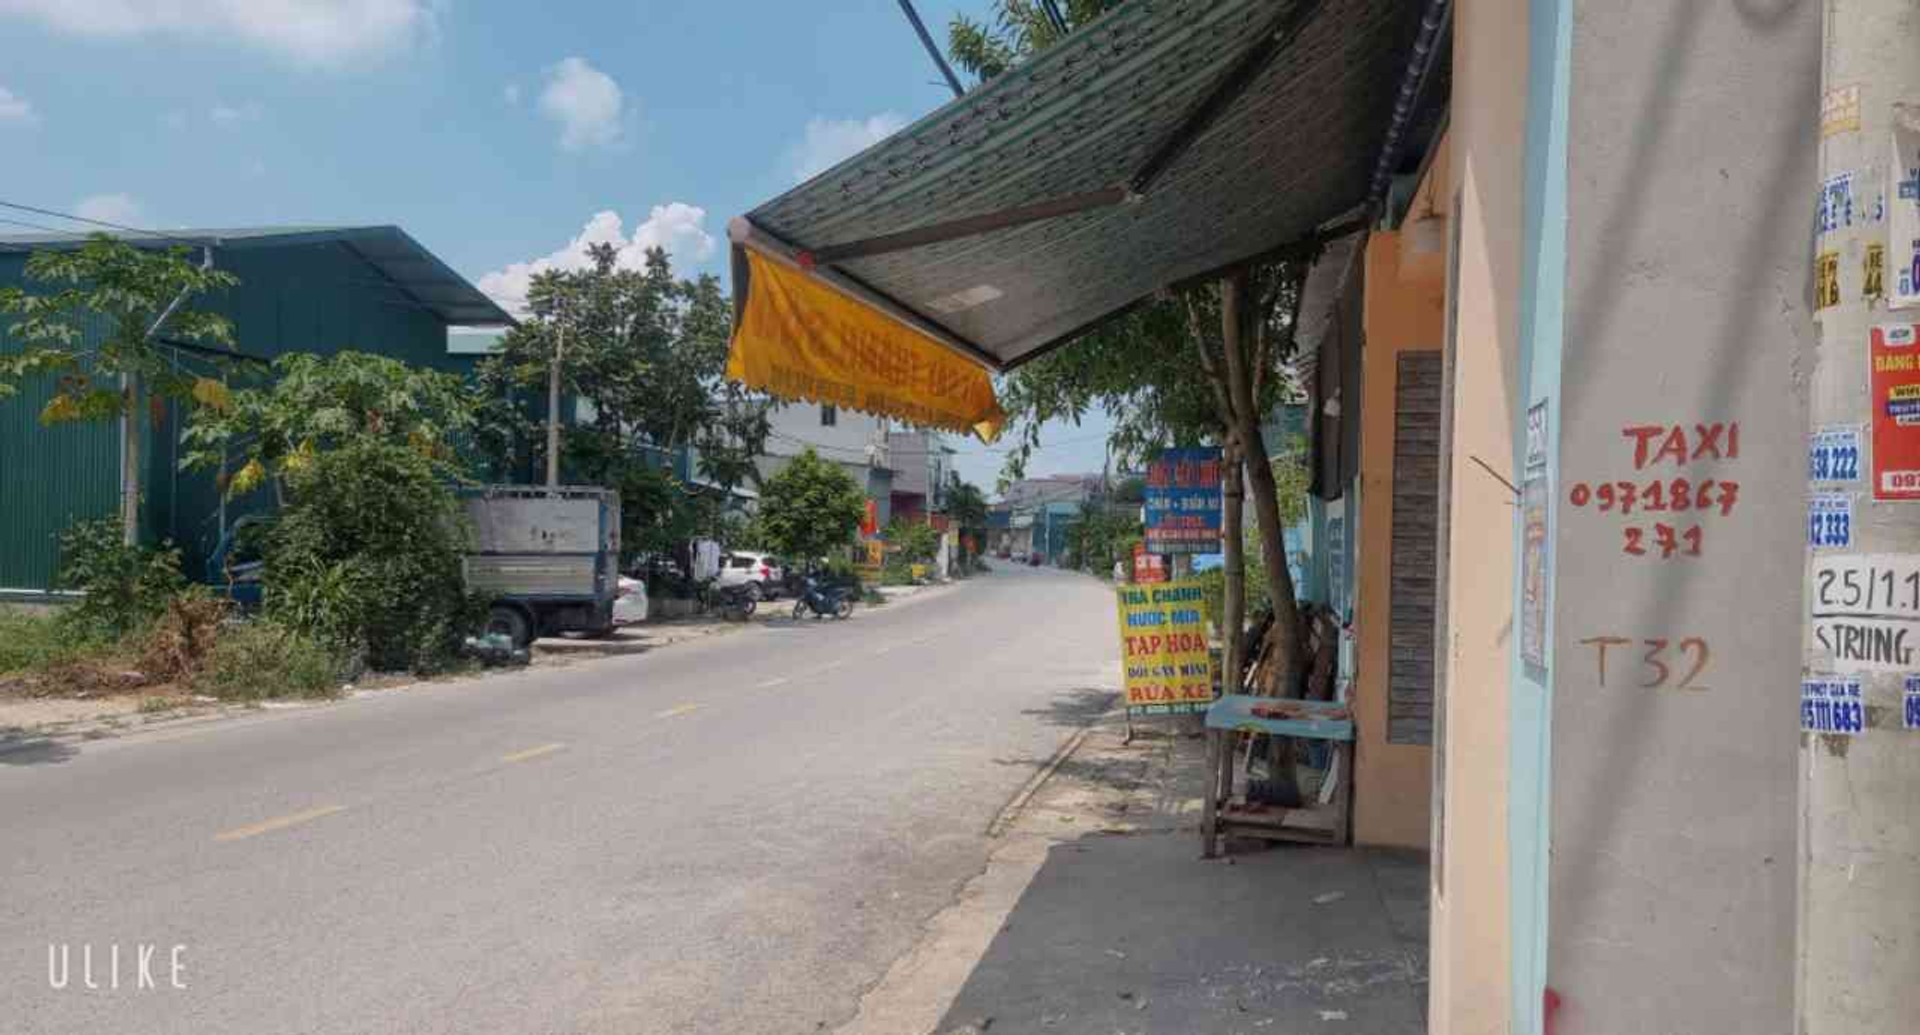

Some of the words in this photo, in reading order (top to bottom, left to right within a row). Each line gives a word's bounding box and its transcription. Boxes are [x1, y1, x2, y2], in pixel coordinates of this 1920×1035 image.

[1622, 421, 1739, 470] TAXI
[1569, 478, 1739, 515] 0971867
[1623, 522, 1703, 558] 271
